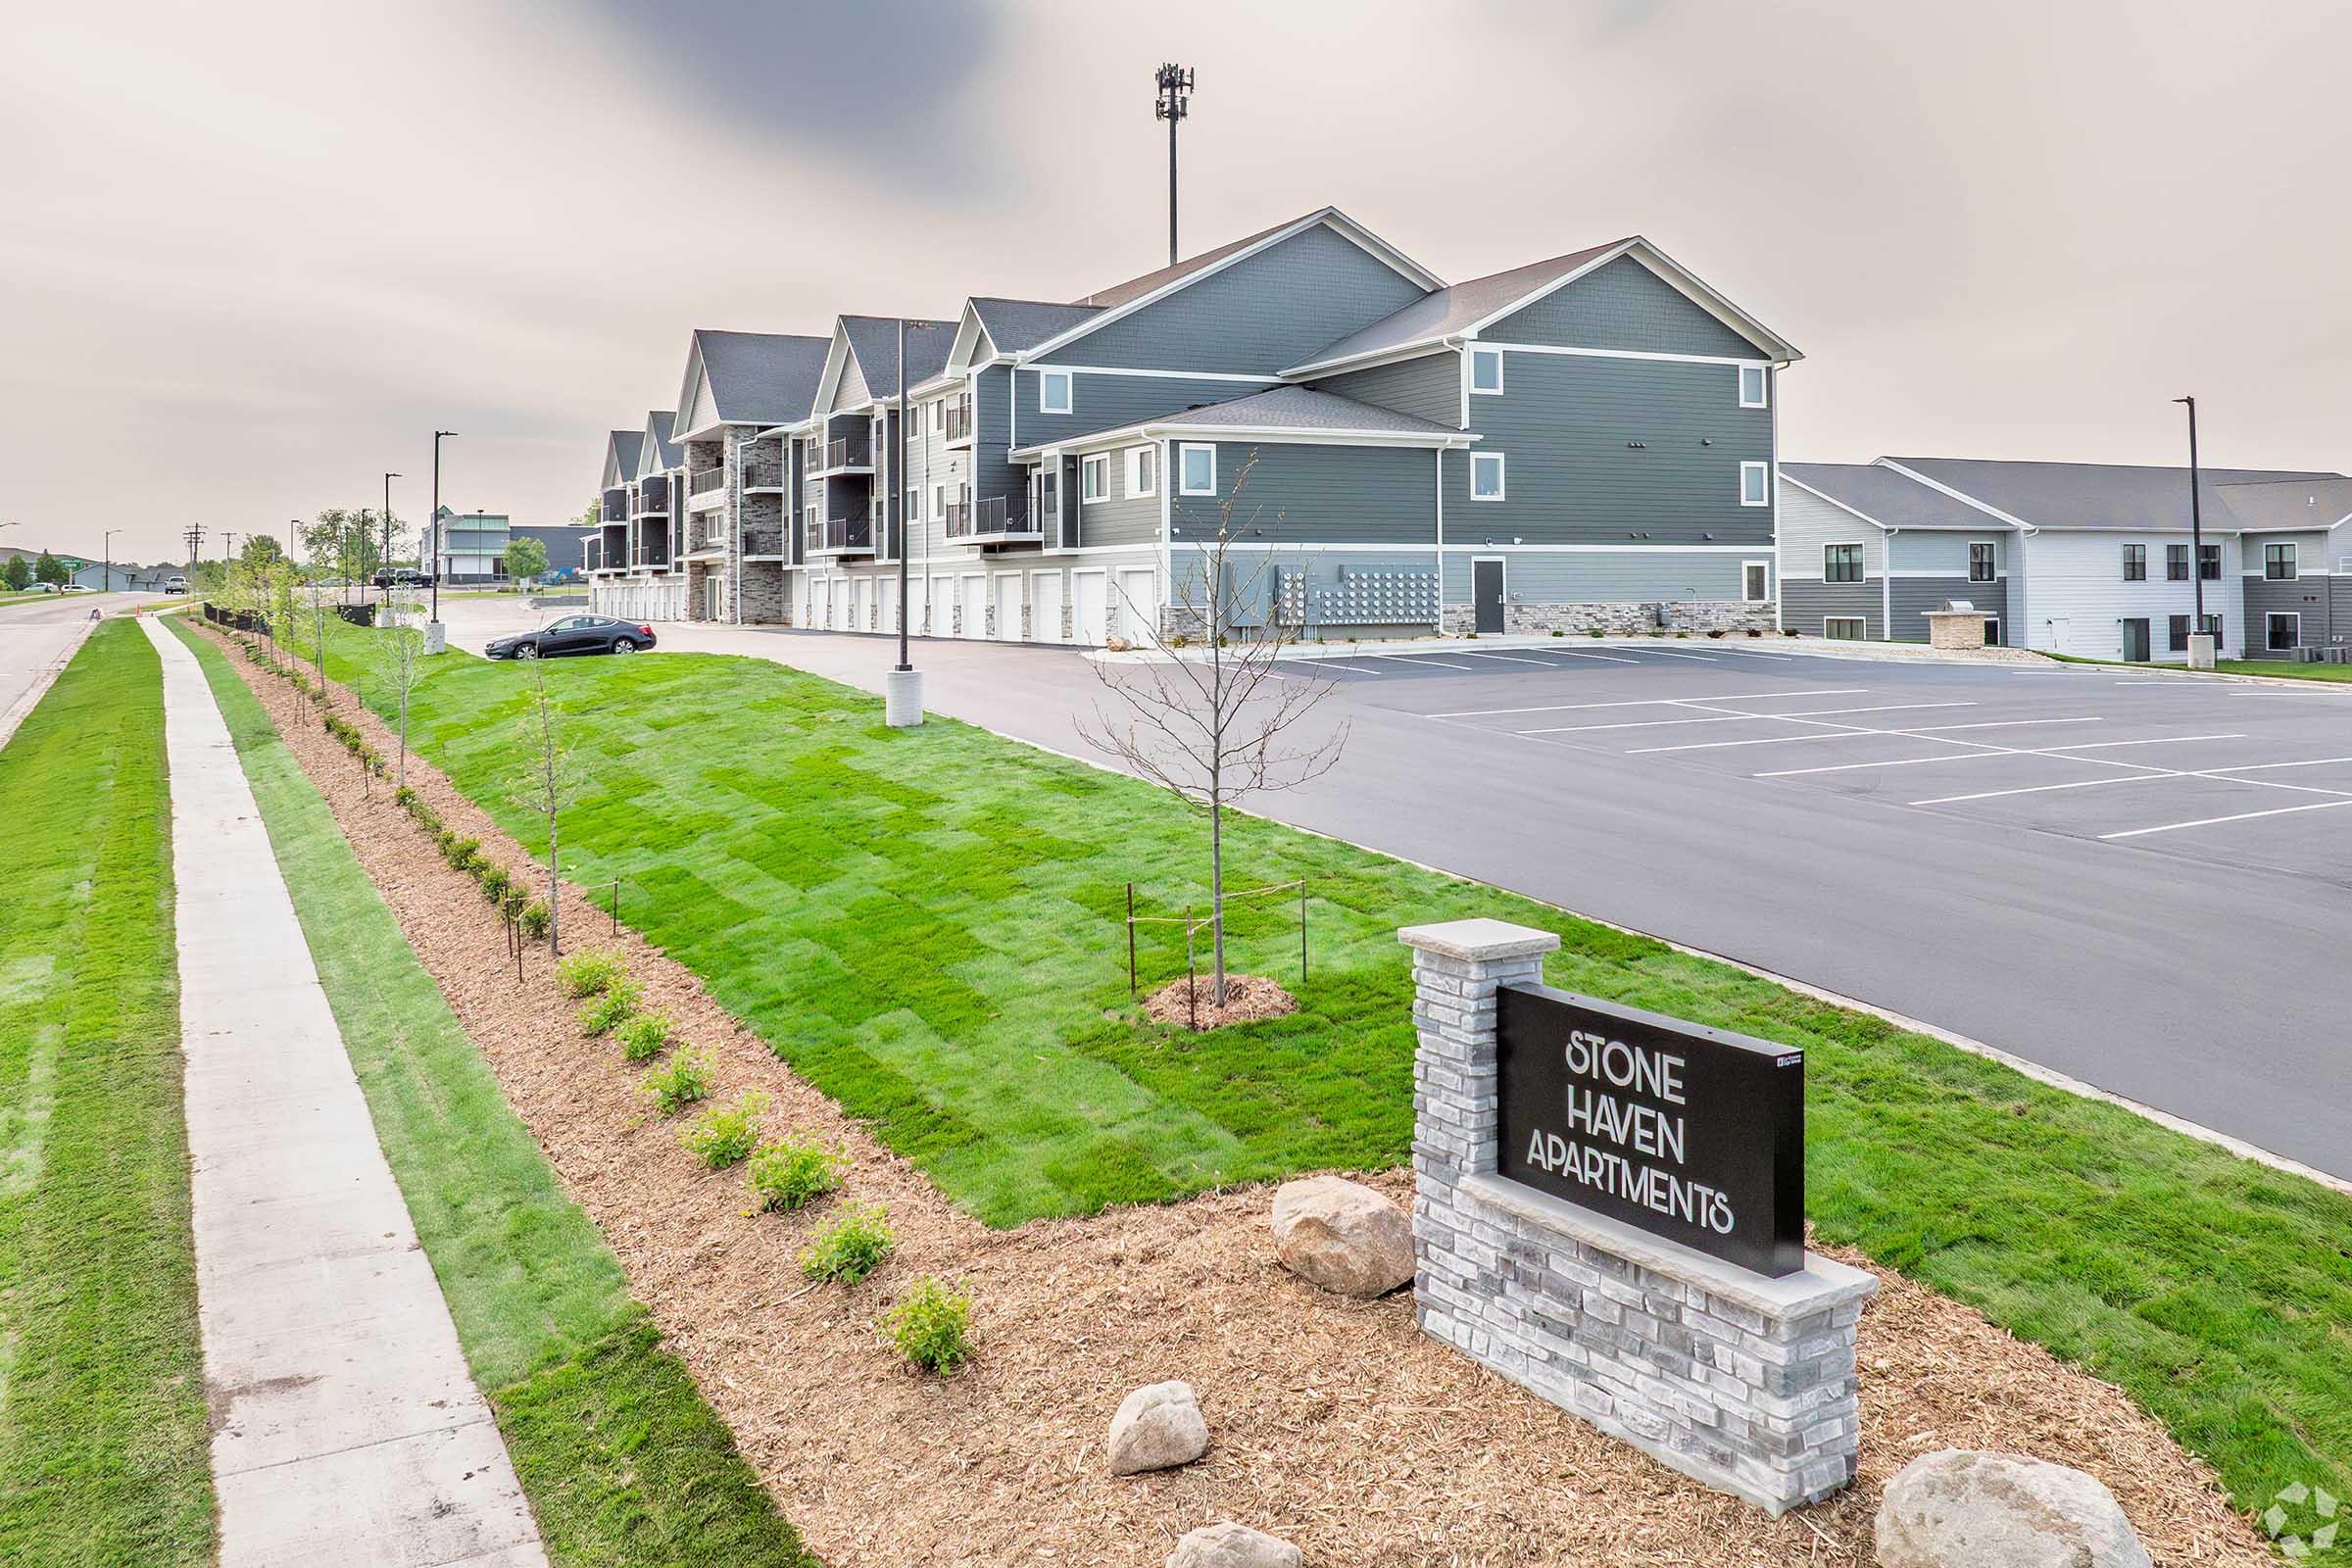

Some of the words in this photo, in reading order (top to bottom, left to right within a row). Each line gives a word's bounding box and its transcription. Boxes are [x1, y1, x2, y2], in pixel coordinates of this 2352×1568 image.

[1565, 1030, 1686, 1104] STONE
[1567, 1083, 1685, 1164] HAVEN
[1526, 1128, 1735, 1235] APARTMENTS
